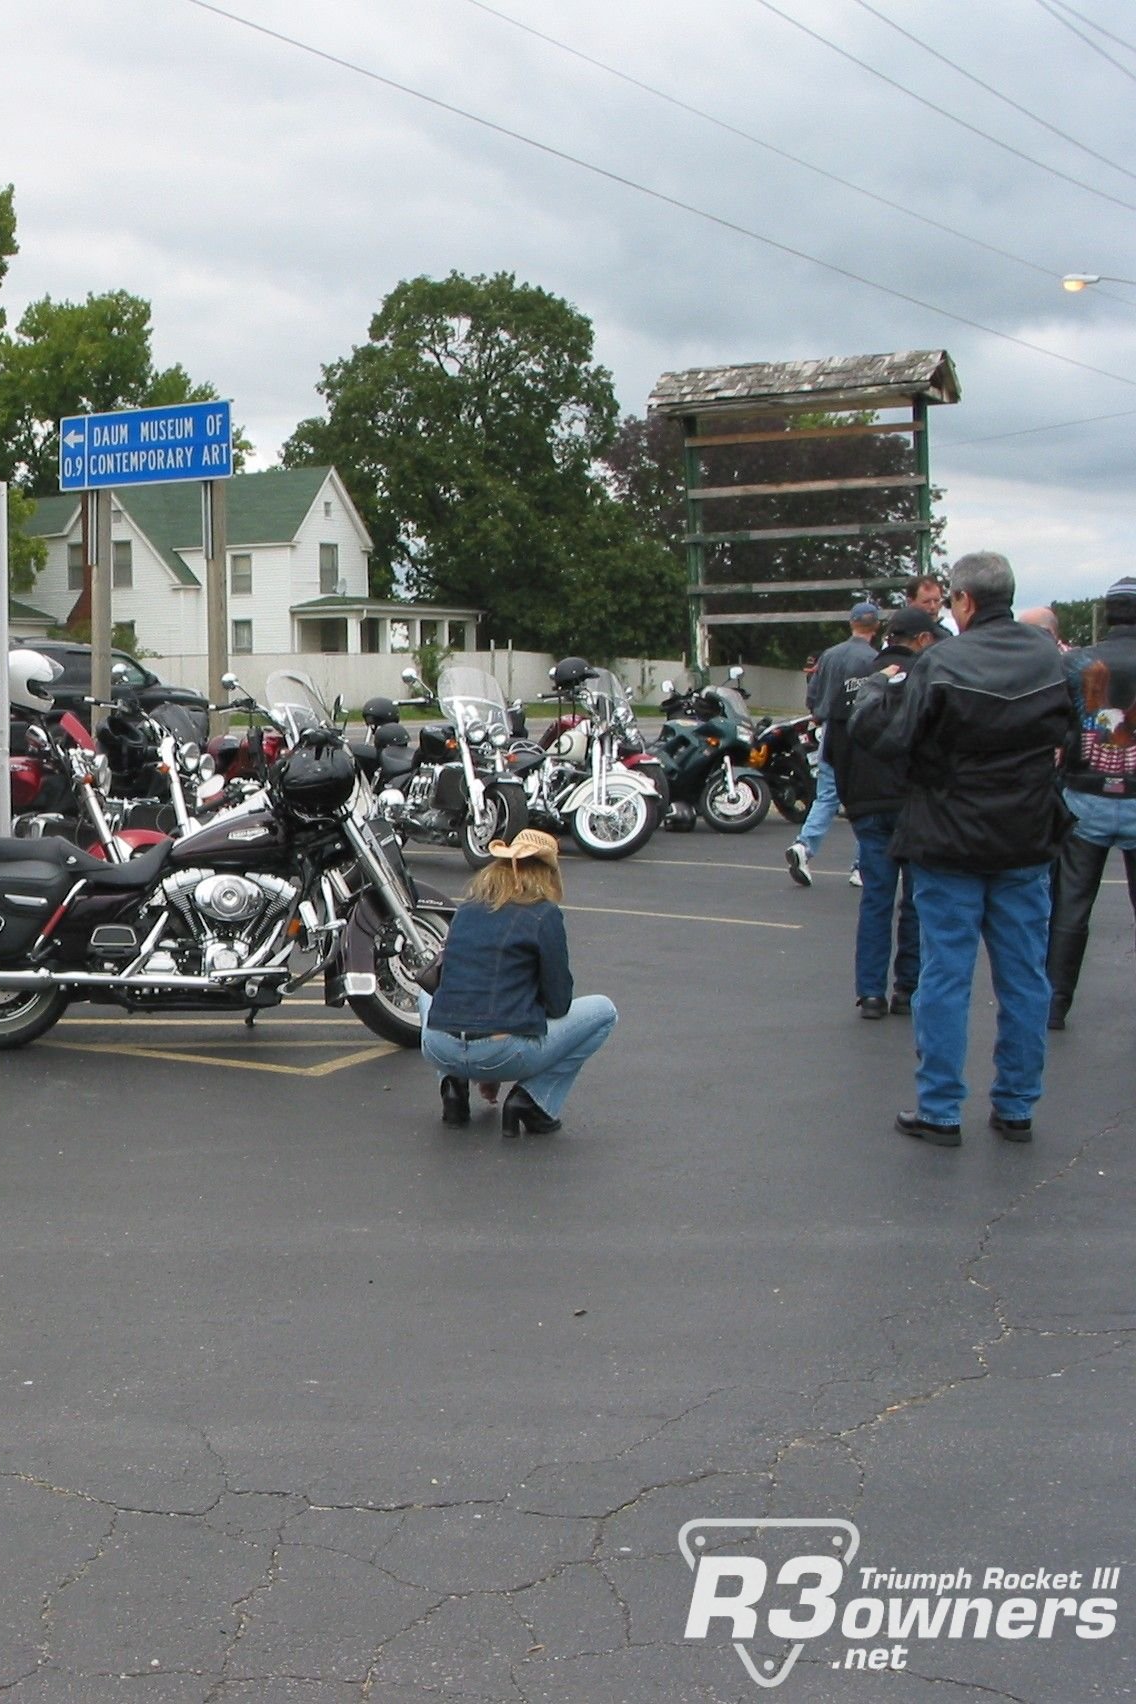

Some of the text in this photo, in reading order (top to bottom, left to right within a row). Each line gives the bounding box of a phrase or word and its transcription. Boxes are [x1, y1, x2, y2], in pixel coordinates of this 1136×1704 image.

[93, 413, 224, 447] DAUM MUSEUM OF
[64, 456, 83, 478] 0.9
[90, 443, 228, 476] CONTEMPORARY ART
